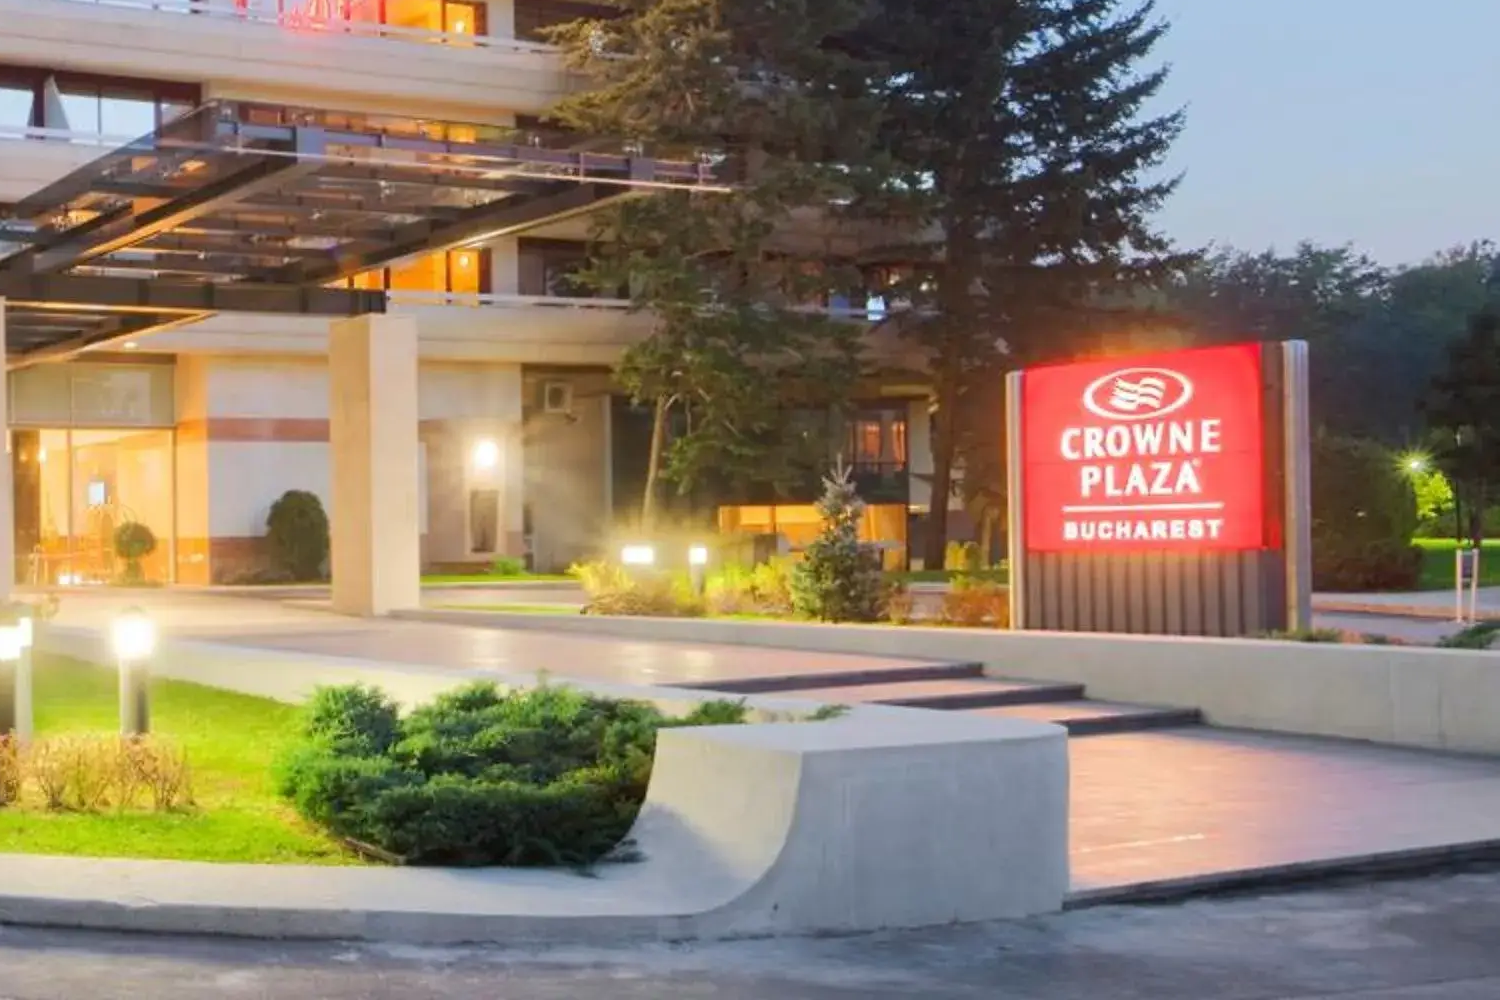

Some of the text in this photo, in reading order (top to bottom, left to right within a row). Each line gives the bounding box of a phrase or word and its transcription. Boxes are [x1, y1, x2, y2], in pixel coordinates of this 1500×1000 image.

[1060, 418, 1221, 460] CROWNE
[1080, 461, 1201, 498] PLAZA
[1062, 518, 1224, 541] BUCHAREST
